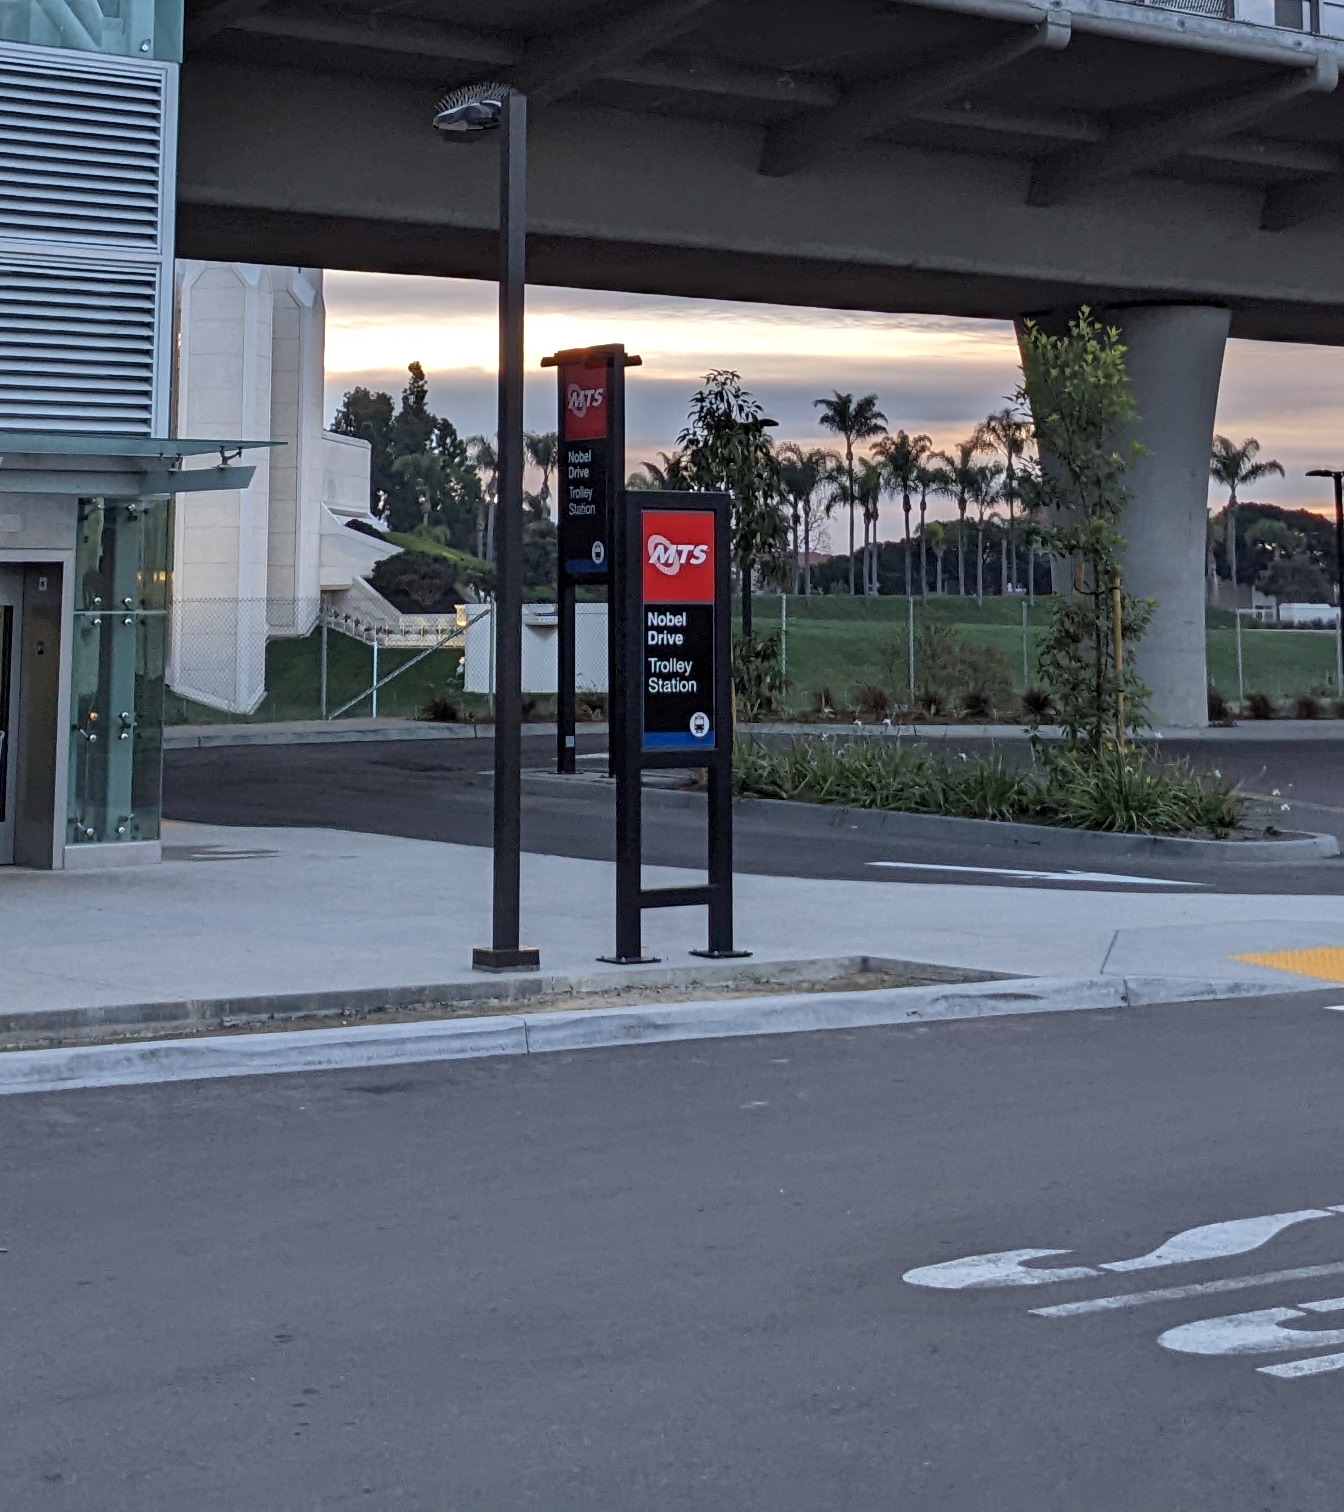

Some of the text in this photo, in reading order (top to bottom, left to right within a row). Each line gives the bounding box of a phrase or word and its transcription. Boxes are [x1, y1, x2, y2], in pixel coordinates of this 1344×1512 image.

[568, 388, 604, 409] MTS
[568, 450, 592, 463] Nobel
[568, 467, 590, 479] Drive
[568, 486, 593, 501] Trolley
[568, 502, 596, 515] Station
[648, 544, 709, 565] MTS
[647, 611, 687, 626] Nobel
[647, 630, 684, 645] Drive
[648, 657, 693, 676] Trolley
[648, 677, 697, 693] Station
